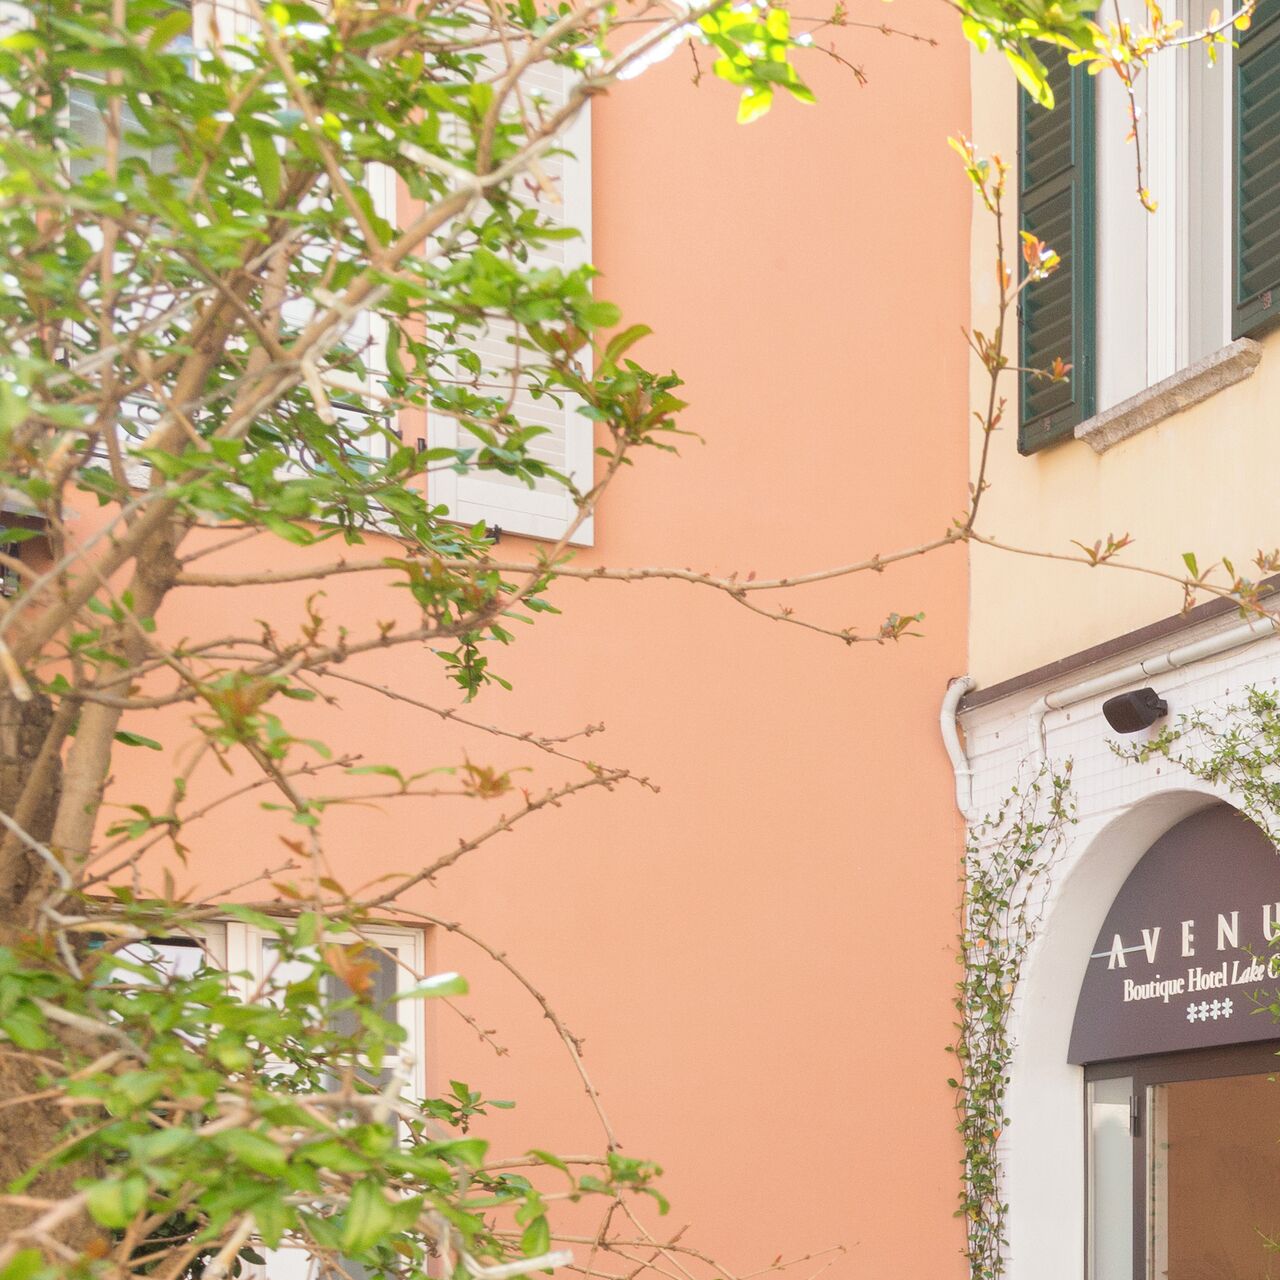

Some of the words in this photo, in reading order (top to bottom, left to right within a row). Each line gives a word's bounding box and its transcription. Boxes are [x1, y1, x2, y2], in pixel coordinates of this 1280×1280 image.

[1123, 974, 1185, 1004] Boutique
[1187, 962, 1228, 993] Hotel
[1231, 955, 1265, 986] Lake
